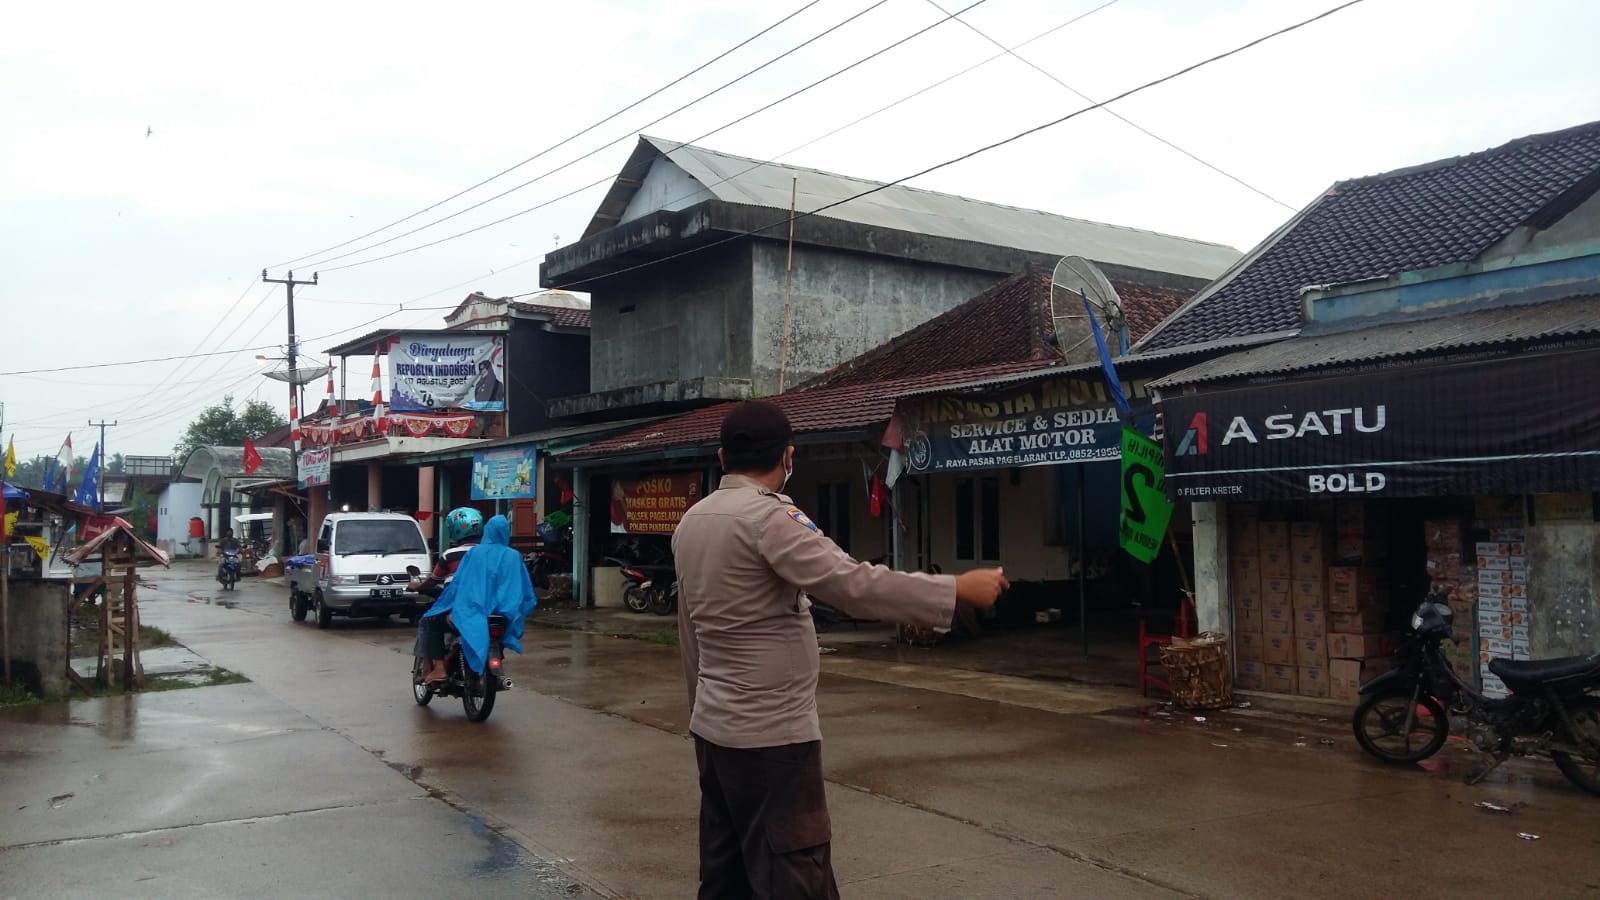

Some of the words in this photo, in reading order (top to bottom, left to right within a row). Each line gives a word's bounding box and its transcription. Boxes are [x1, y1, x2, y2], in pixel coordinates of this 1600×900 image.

[396, 362, 434, 377] REPUBLIK
[435, 362, 477, 377] INDONESIA
[416, 377, 448, 386] AGUSTUS
[419, 390, 435, 407] 76
[950, 418, 1027, 440] SERVICE
[1033, 414, 1048, 431] &
[1054, 407, 1121, 428] SEDIA
[1221, 416, 1258, 446] A
[1264, 404, 1387, 441] SATU
[968, 436, 1014, 455] ALAT
[1020, 428, 1097, 451] MOTOR
[946, 457, 968, 469] RAYA
[969, 455, 995, 467] PASAR
[996, 451, 1047, 466] PAGELARAN
[636, 477, 672, 495] POSKO
[1184, 486, 1211, 497] FILTER
[1212, 485, 1243, 495] KRETEK
[1308, 472, 1387, 494] BOLD
[625, 497, 657, 510] MASKER
[658, 496, 687, 509] GRATIS
[626, 511, 650, 521] POLSEK
